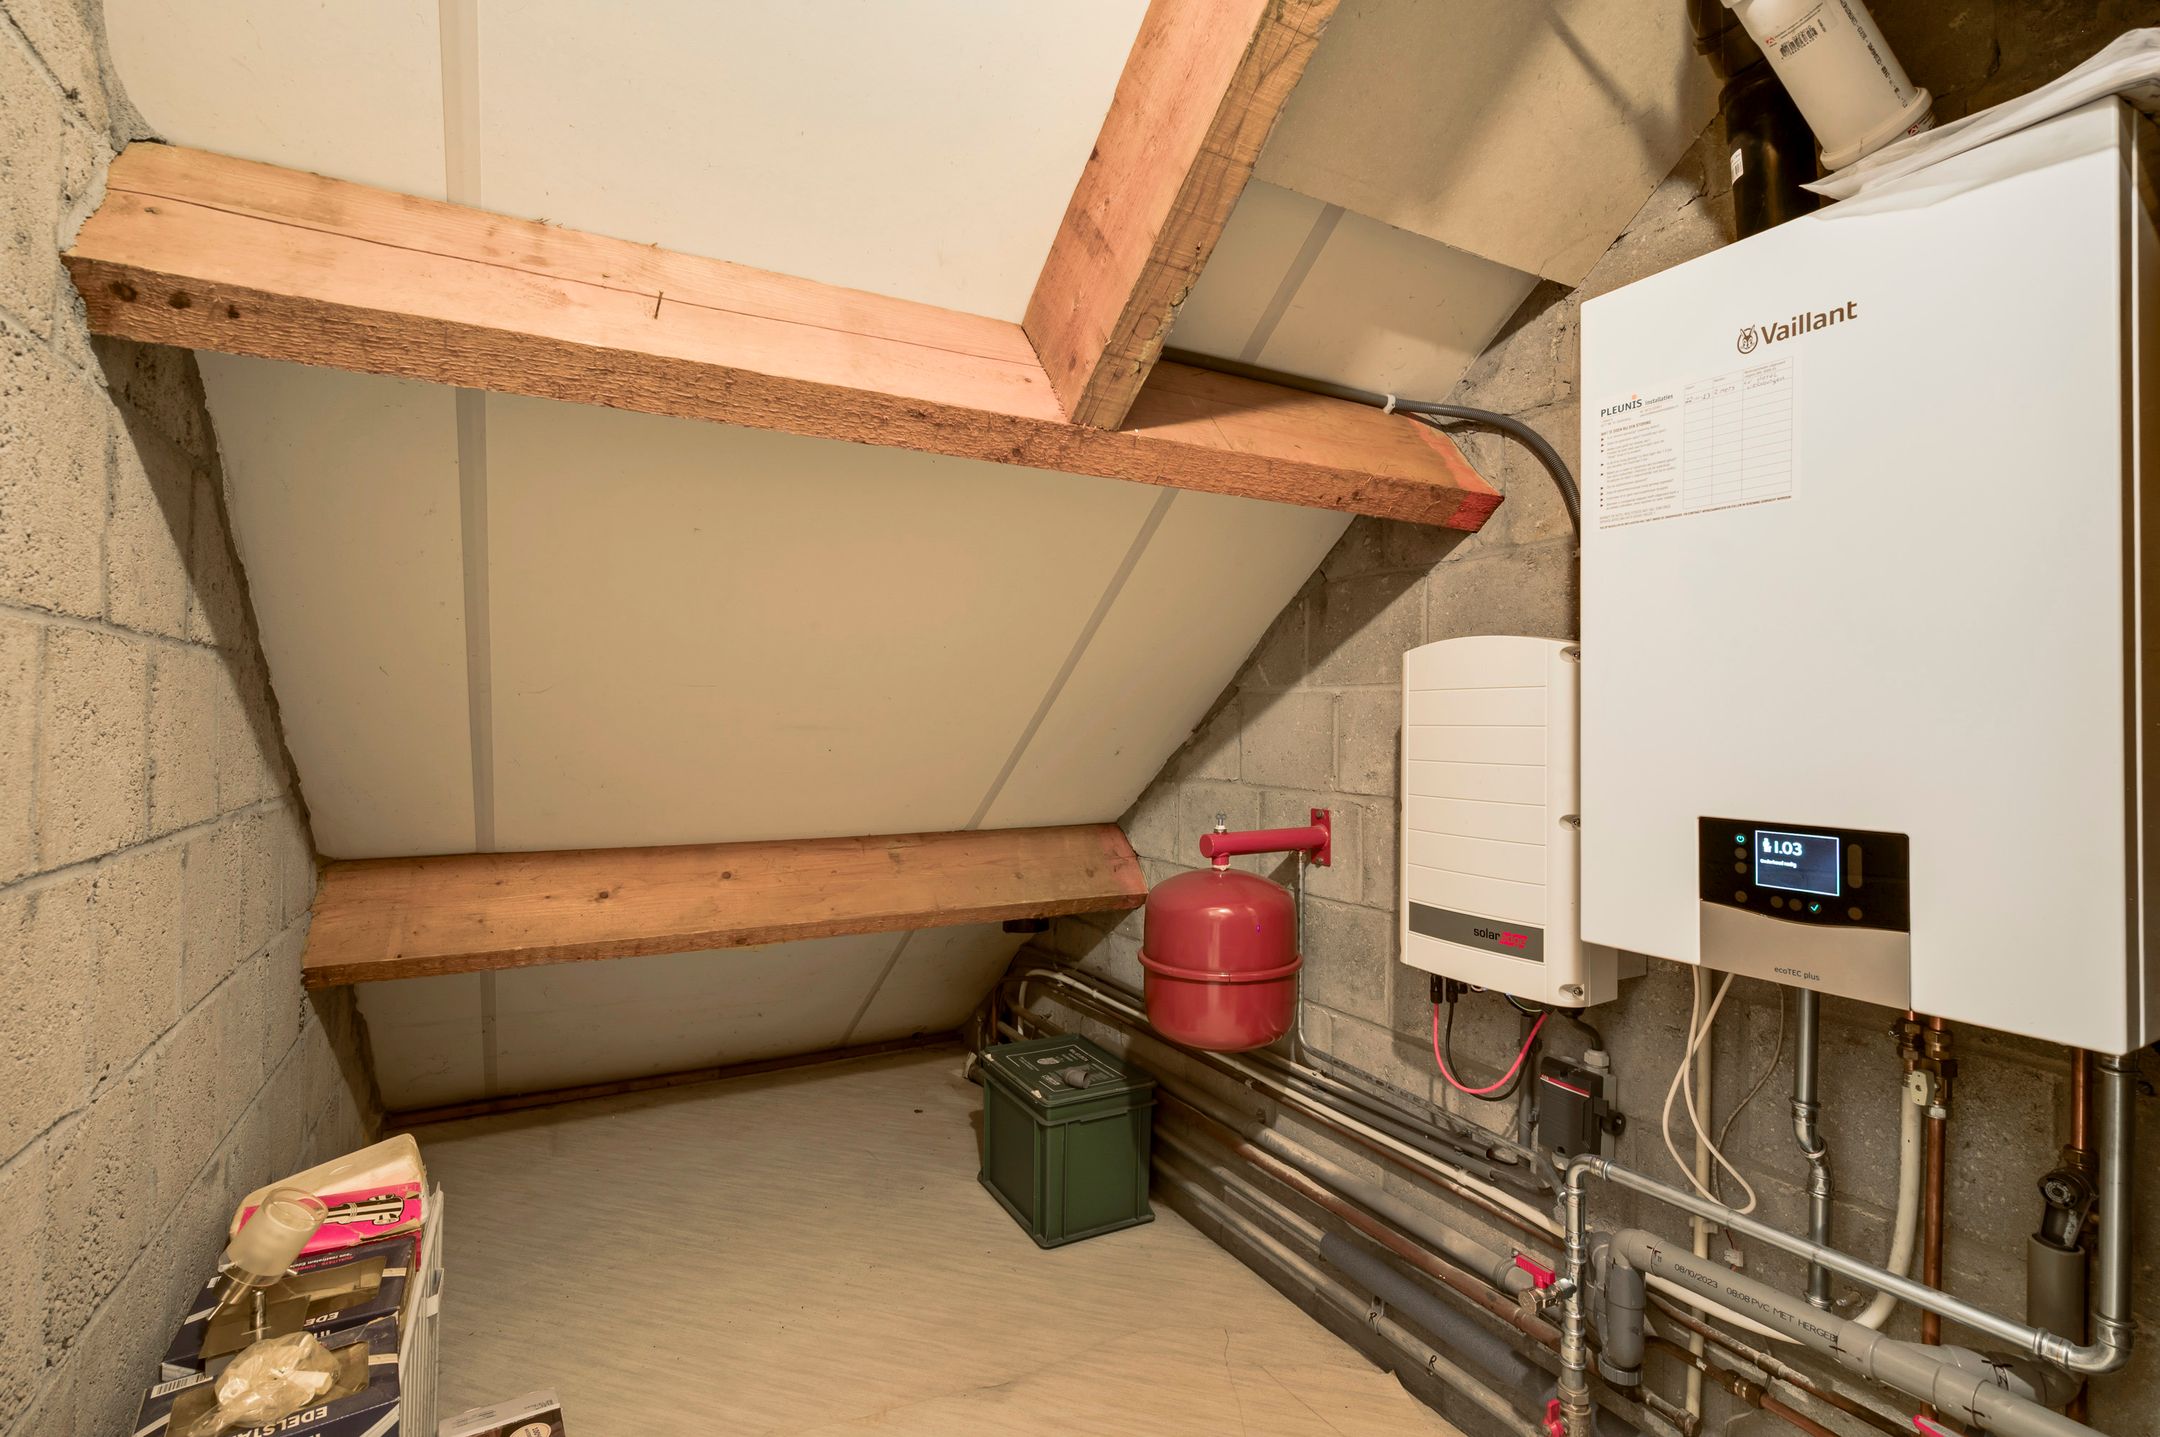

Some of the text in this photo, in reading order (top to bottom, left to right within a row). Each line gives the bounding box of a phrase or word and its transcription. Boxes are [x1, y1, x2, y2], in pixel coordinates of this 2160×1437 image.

[1761, 301, 1858, 345] Vaillant
[1600, 398, 1643, 417] PLEUNIS
[1645, 393, 1674, 406] installaties
[1774, 967, 1820, 982] ecoTEC plus
[1674, 1263, 1719, 1290] 08/10/2023
[1750, 1300, 1771, 1313] PVC
[1773, 1307, 1795, 1323] MET
[1798, 1319, 1839, 1344] HERGEB
[232, 1405, 328, 1437] EDELSTA
